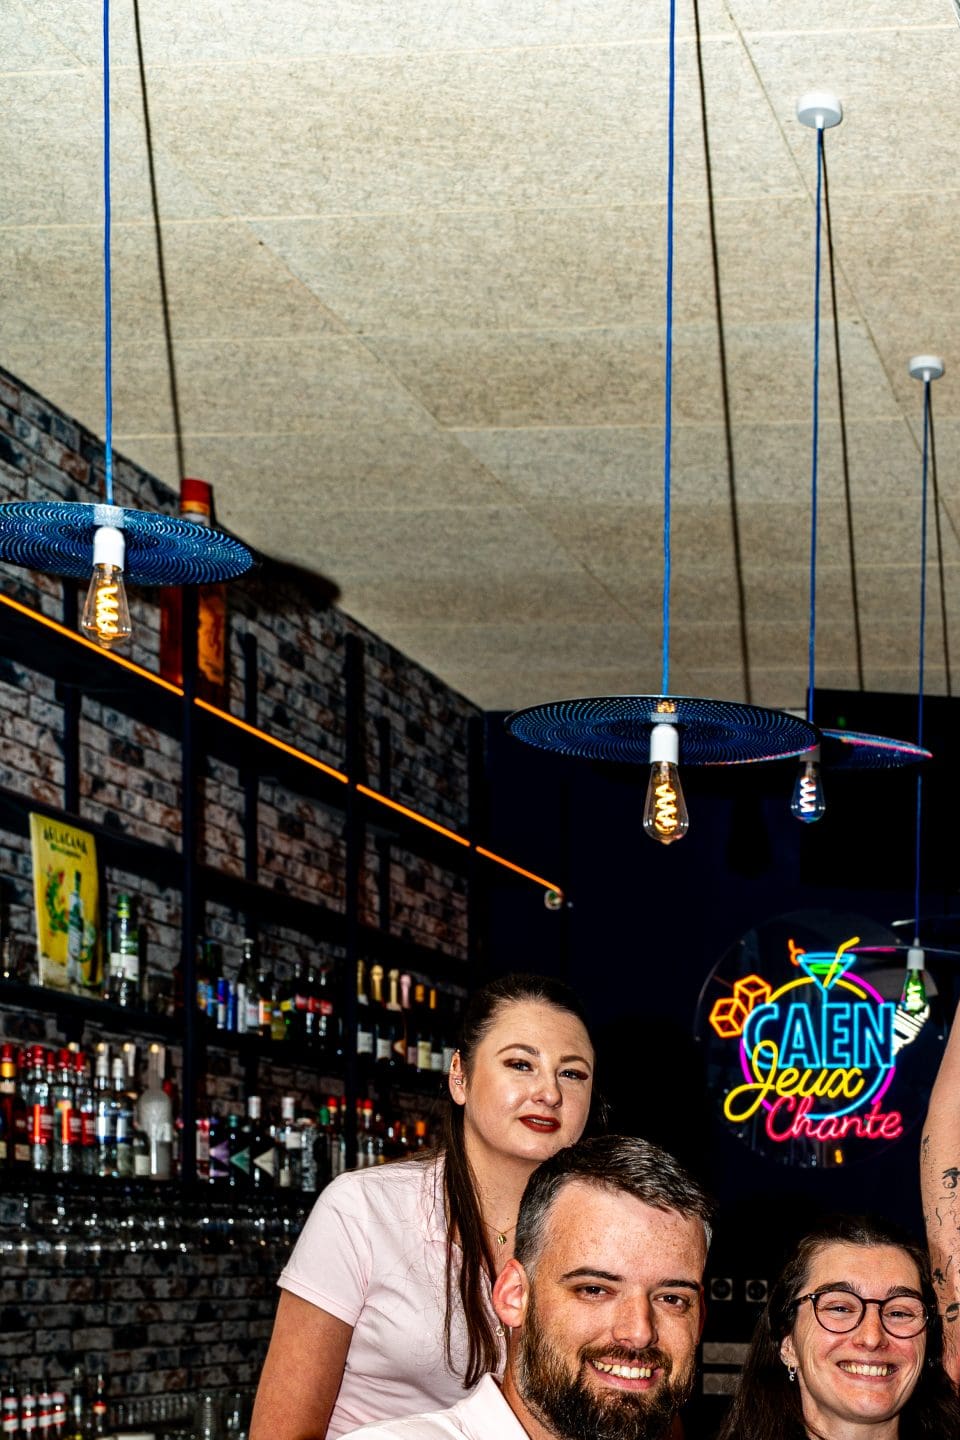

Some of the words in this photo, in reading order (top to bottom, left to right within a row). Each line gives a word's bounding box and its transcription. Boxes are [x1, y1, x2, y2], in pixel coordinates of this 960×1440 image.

[743, 1001, 897, 1070] CAEN
[723, 1039, 866, 1122] Jeux
[765, 1095, 903, 1142] Chante
